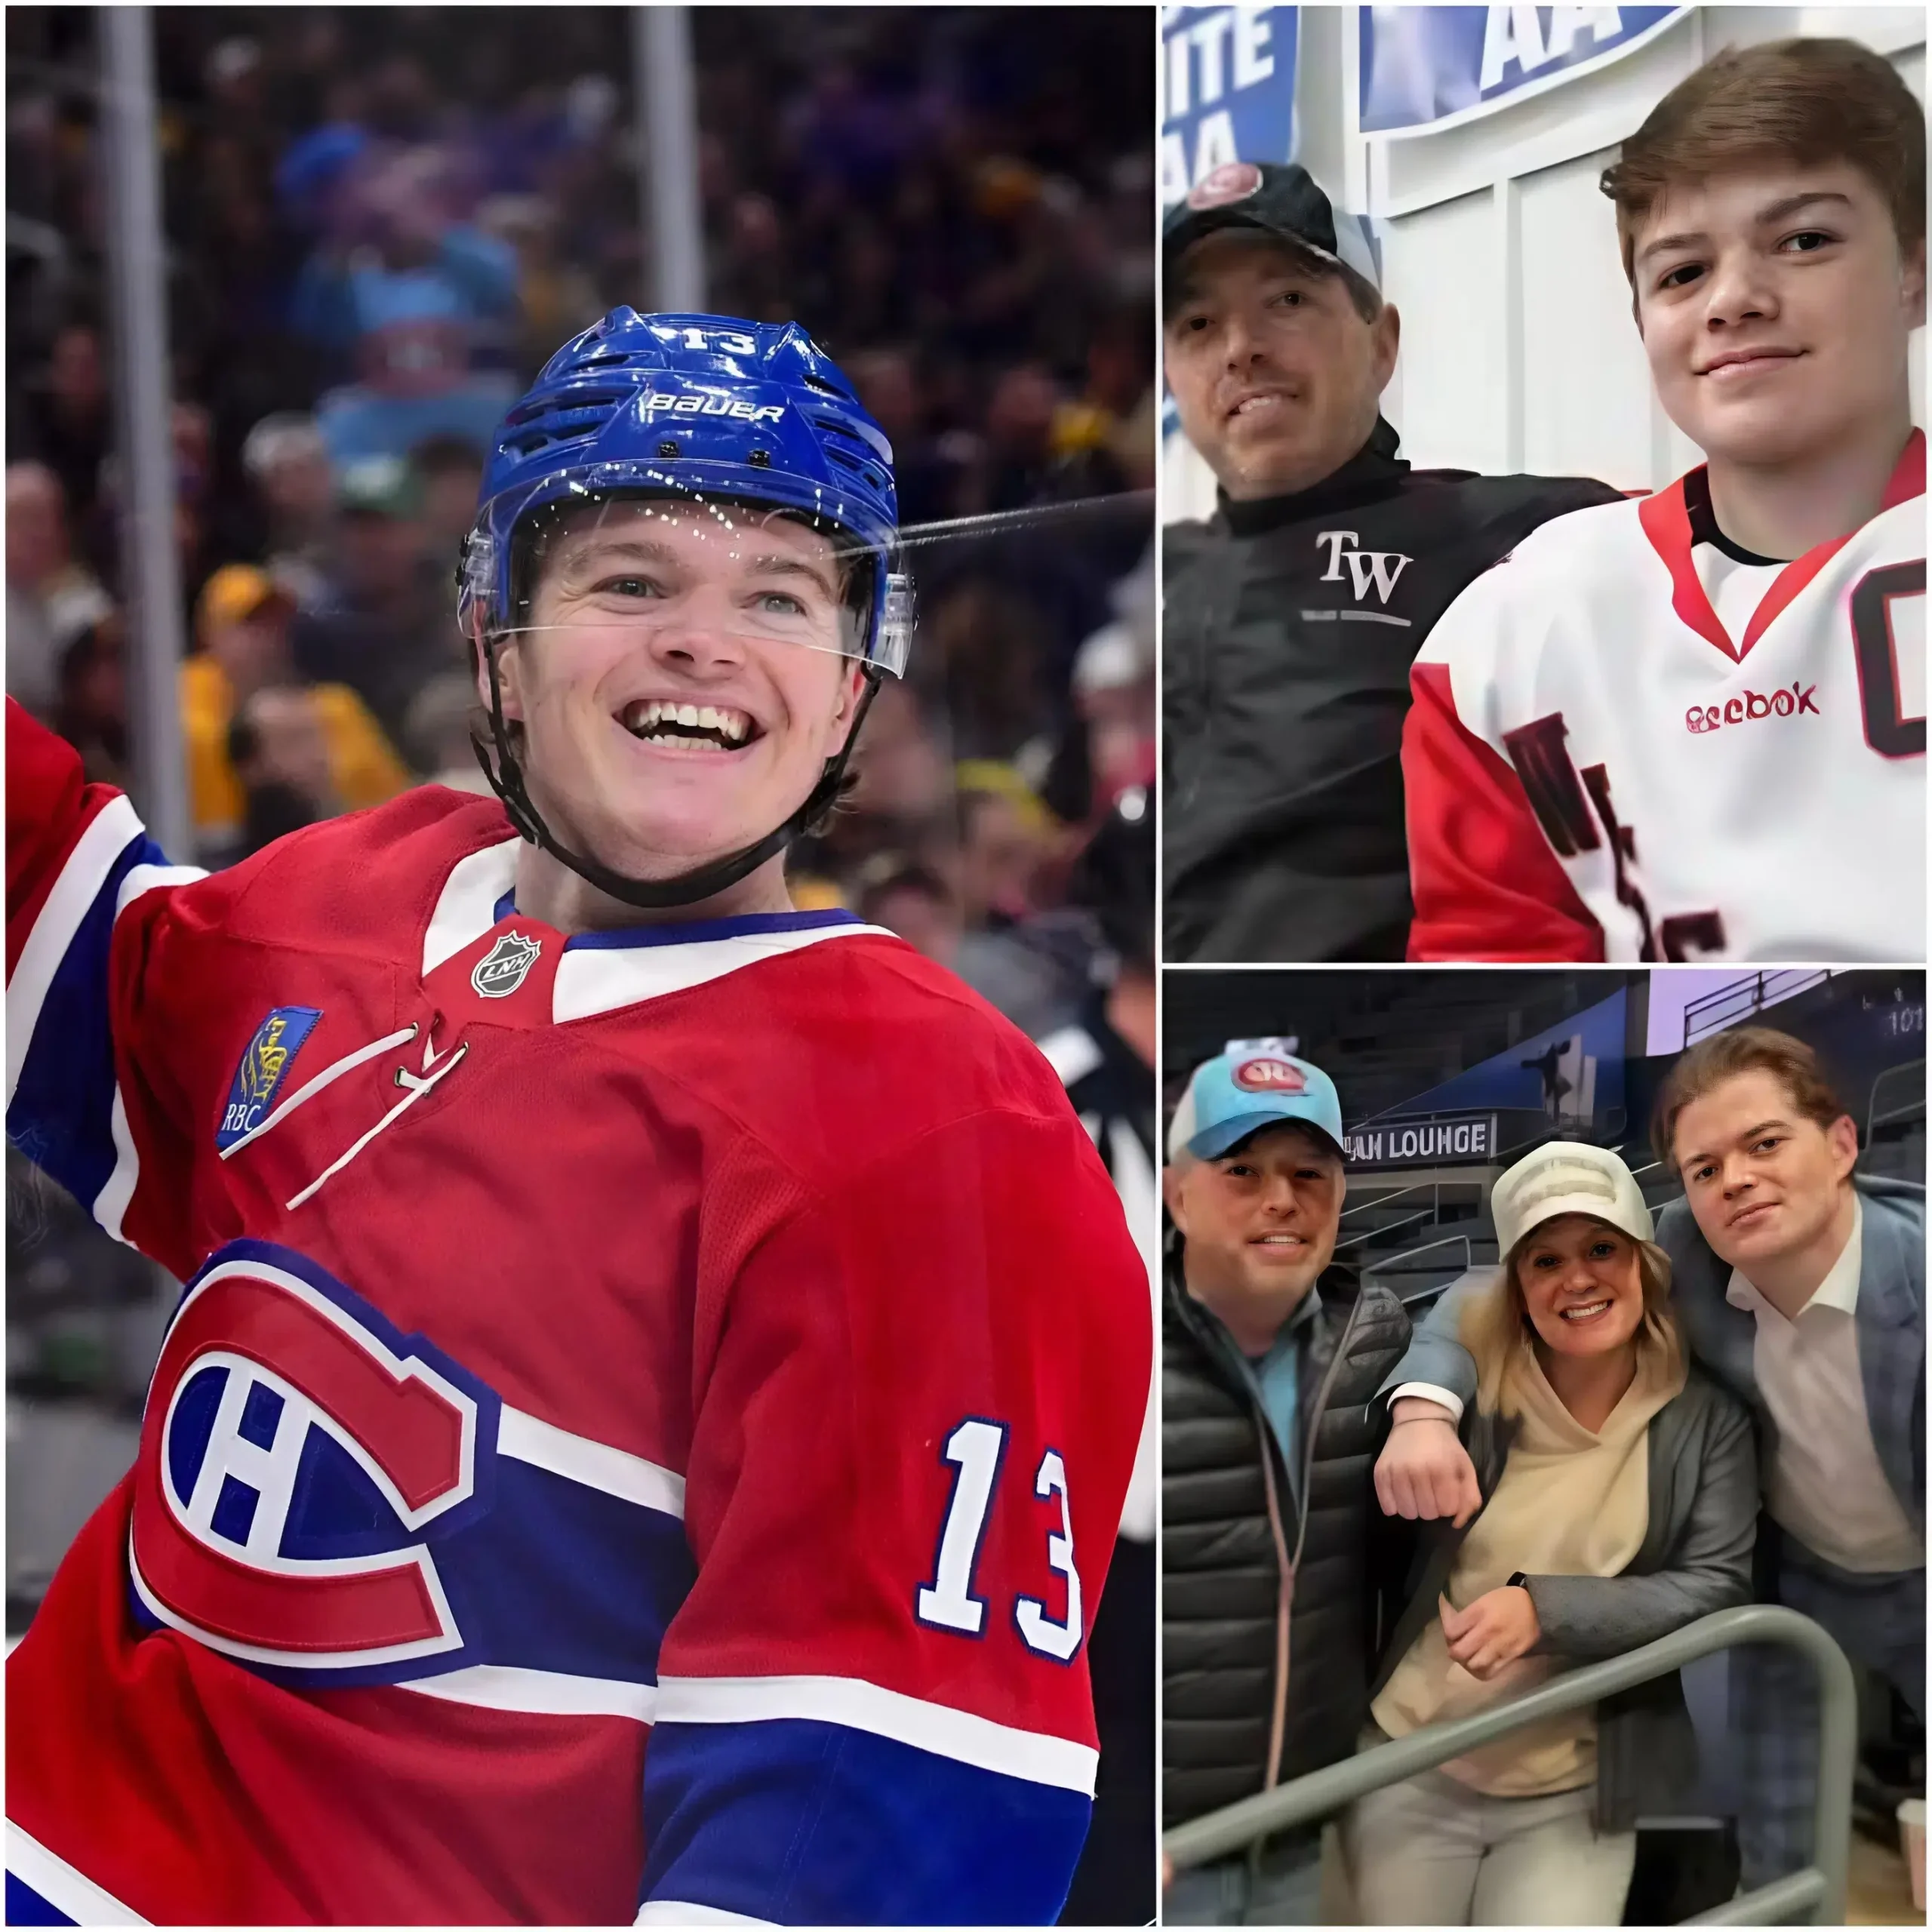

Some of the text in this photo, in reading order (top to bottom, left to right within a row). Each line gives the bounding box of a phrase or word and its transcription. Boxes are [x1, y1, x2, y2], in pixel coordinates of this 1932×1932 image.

[1163, 6, 1274, 119] ITE
[682, 328, 755, 355] 13
[647, 394, 785, 423] BAUER
[1315, 531, 1414, 605] TW
[482, 952, 531, 980] LNH
[221, 1103, 262, 1132] RBC
[1389, 1123, 1486, 1158] LOUNGE
[915, 1416, 1085, 1664] 13
